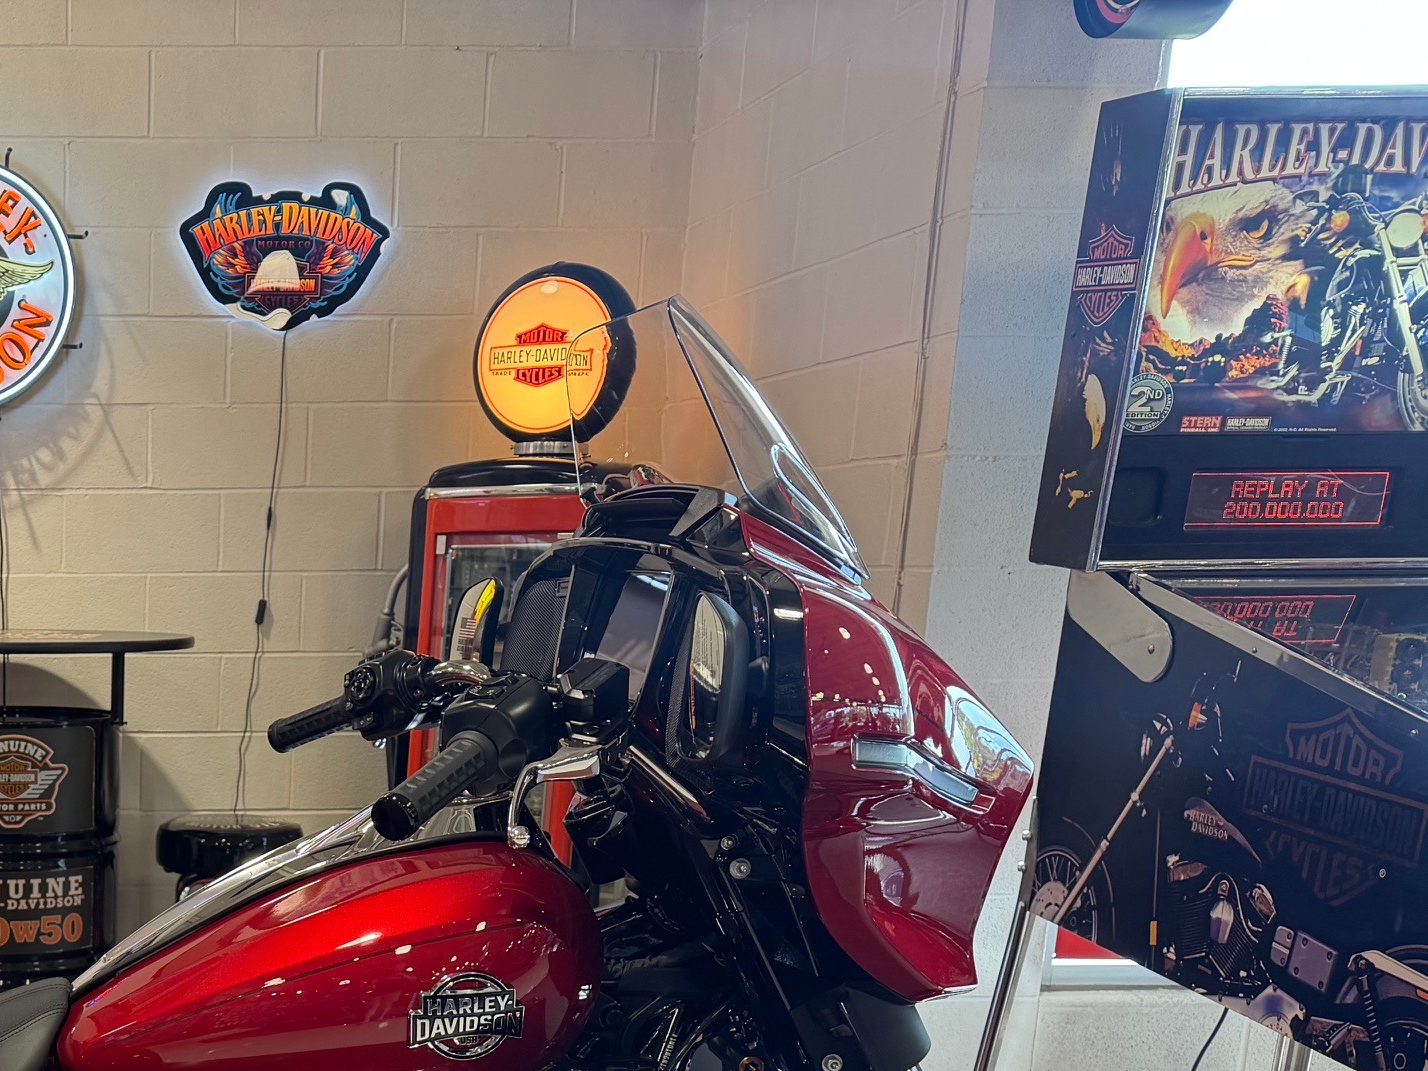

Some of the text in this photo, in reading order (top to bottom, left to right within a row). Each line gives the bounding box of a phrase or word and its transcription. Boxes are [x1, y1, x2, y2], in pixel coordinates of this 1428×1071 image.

[192, 202, 379, 262] HARLEY-DAVIDSON
[258, 240, 311, 248] MOTOR CO
[1094, 237, 1125, 259] MOTOR
[1076, 264, 1136, 286] HARLEY-DAVIDSON
[1086, 291, 1119, 316] CYCLES
[521, 329, 565, 345] MOTOR
[518, 367, 561, 384] CYCLES
[1182, 416, 1222, 427] STERN
[1230, 480, 1343, 498] REPLAY AT
[1296, 722, 1386, 784] MOTOR
[17, 803, 47, 811] PARTS
[1248, 765, 1420, 854] HARLEY-DAVIDSON
[1190, 822, 1229, 841] DAVIDSON
[1276, 833, 1364, 898] CYCLES
[416, 1010, 522, 1043] DAVIDSON
[460, 1035, 479, 1045] USA
